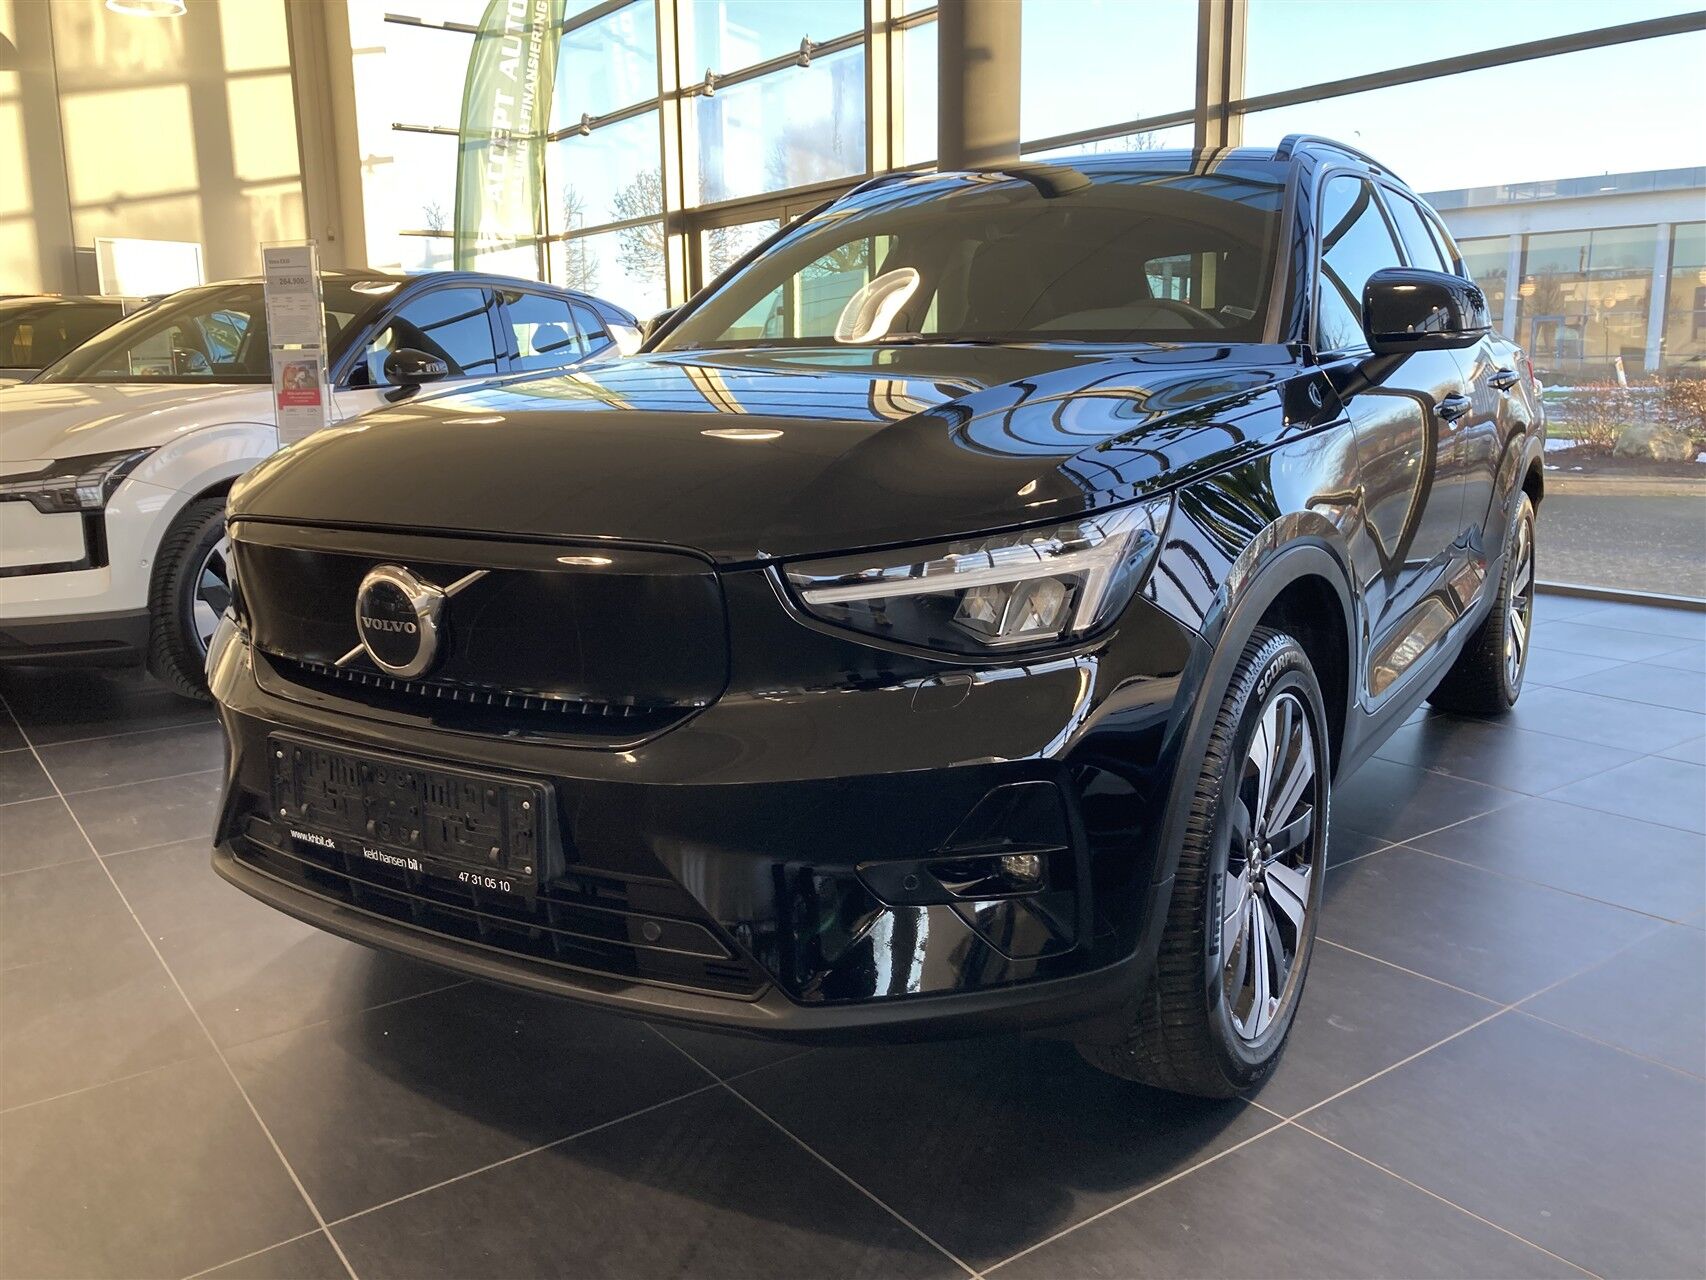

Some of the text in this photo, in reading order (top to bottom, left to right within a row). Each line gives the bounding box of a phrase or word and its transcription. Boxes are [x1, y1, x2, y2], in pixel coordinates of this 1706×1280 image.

[499, 0, 528, 82] AUTO
[520, 0, 549, 121] FINANSIERING
[361, 616, 417, 634] VOLVO
[290, 829, 336, 849] www.khbil.dk
[363, 847, 379, 861] keld
[379, 851, 407, 867] hansen
[458, 871, 511, 893] 47 31 05 10
